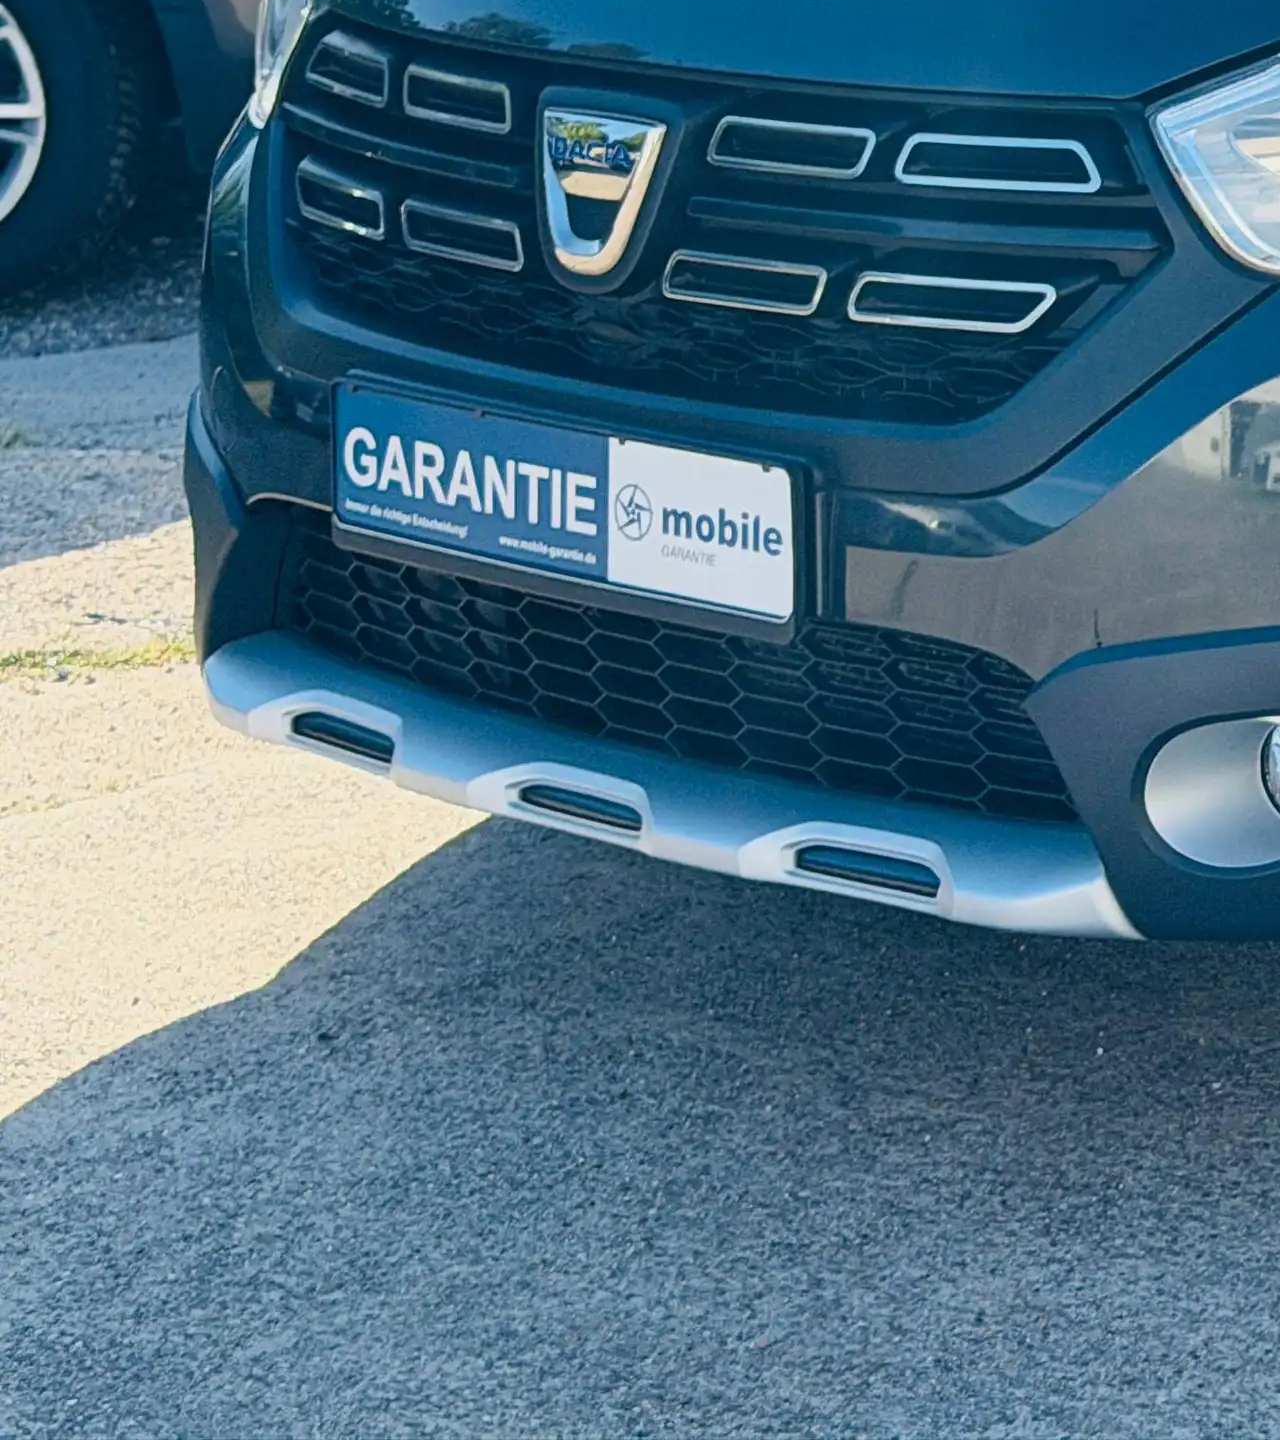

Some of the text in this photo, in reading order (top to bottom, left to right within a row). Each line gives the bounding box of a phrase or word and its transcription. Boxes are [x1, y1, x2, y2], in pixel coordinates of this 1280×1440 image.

[551, 136, 633, 167] DACIA
[344, 426, 597, 536] GARANTIE
[662, 506, 783, 556] mobile
[499, 535, 597, 565] www.mobile-garantie.de
[661, 545, 717, 567] GARANTIE
